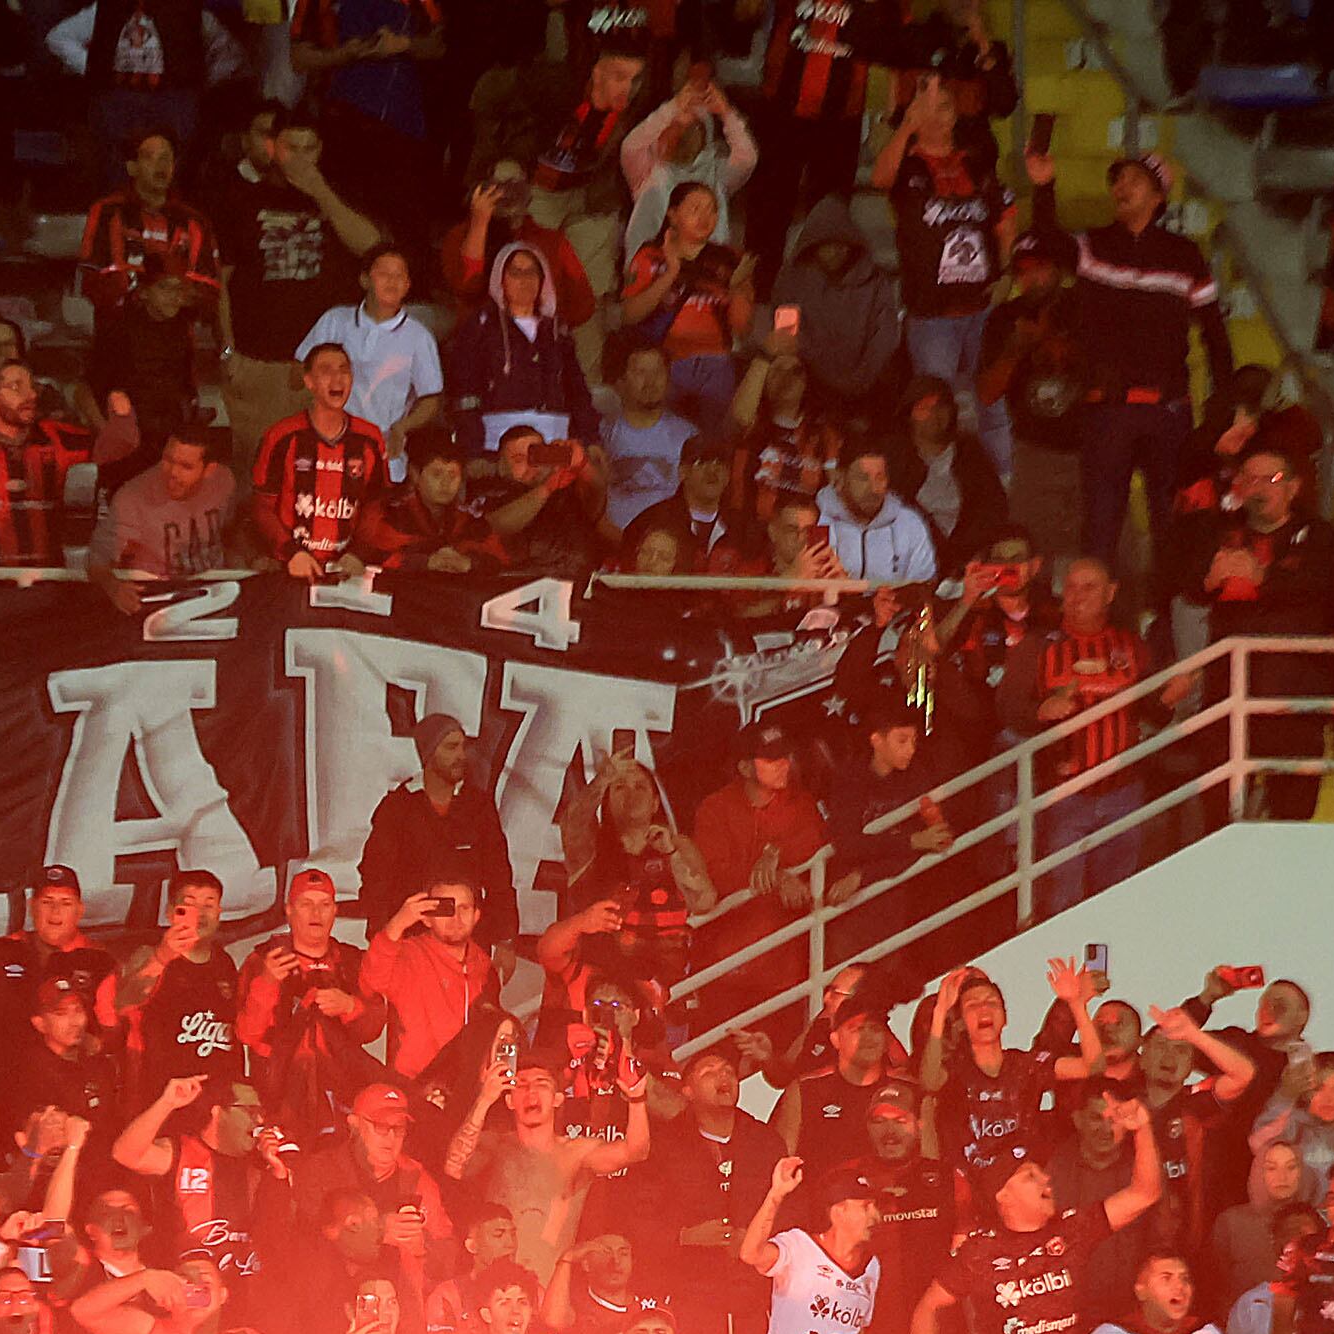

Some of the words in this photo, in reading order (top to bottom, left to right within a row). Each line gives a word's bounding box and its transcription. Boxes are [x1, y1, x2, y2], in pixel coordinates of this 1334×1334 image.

[178, 1167, 210, 1193] 12
[883, 1207, 938, 1223] movistar
[1018, 1268, 1072, 1299] kölbi
[830, 1303, 870, 1330] kölb
